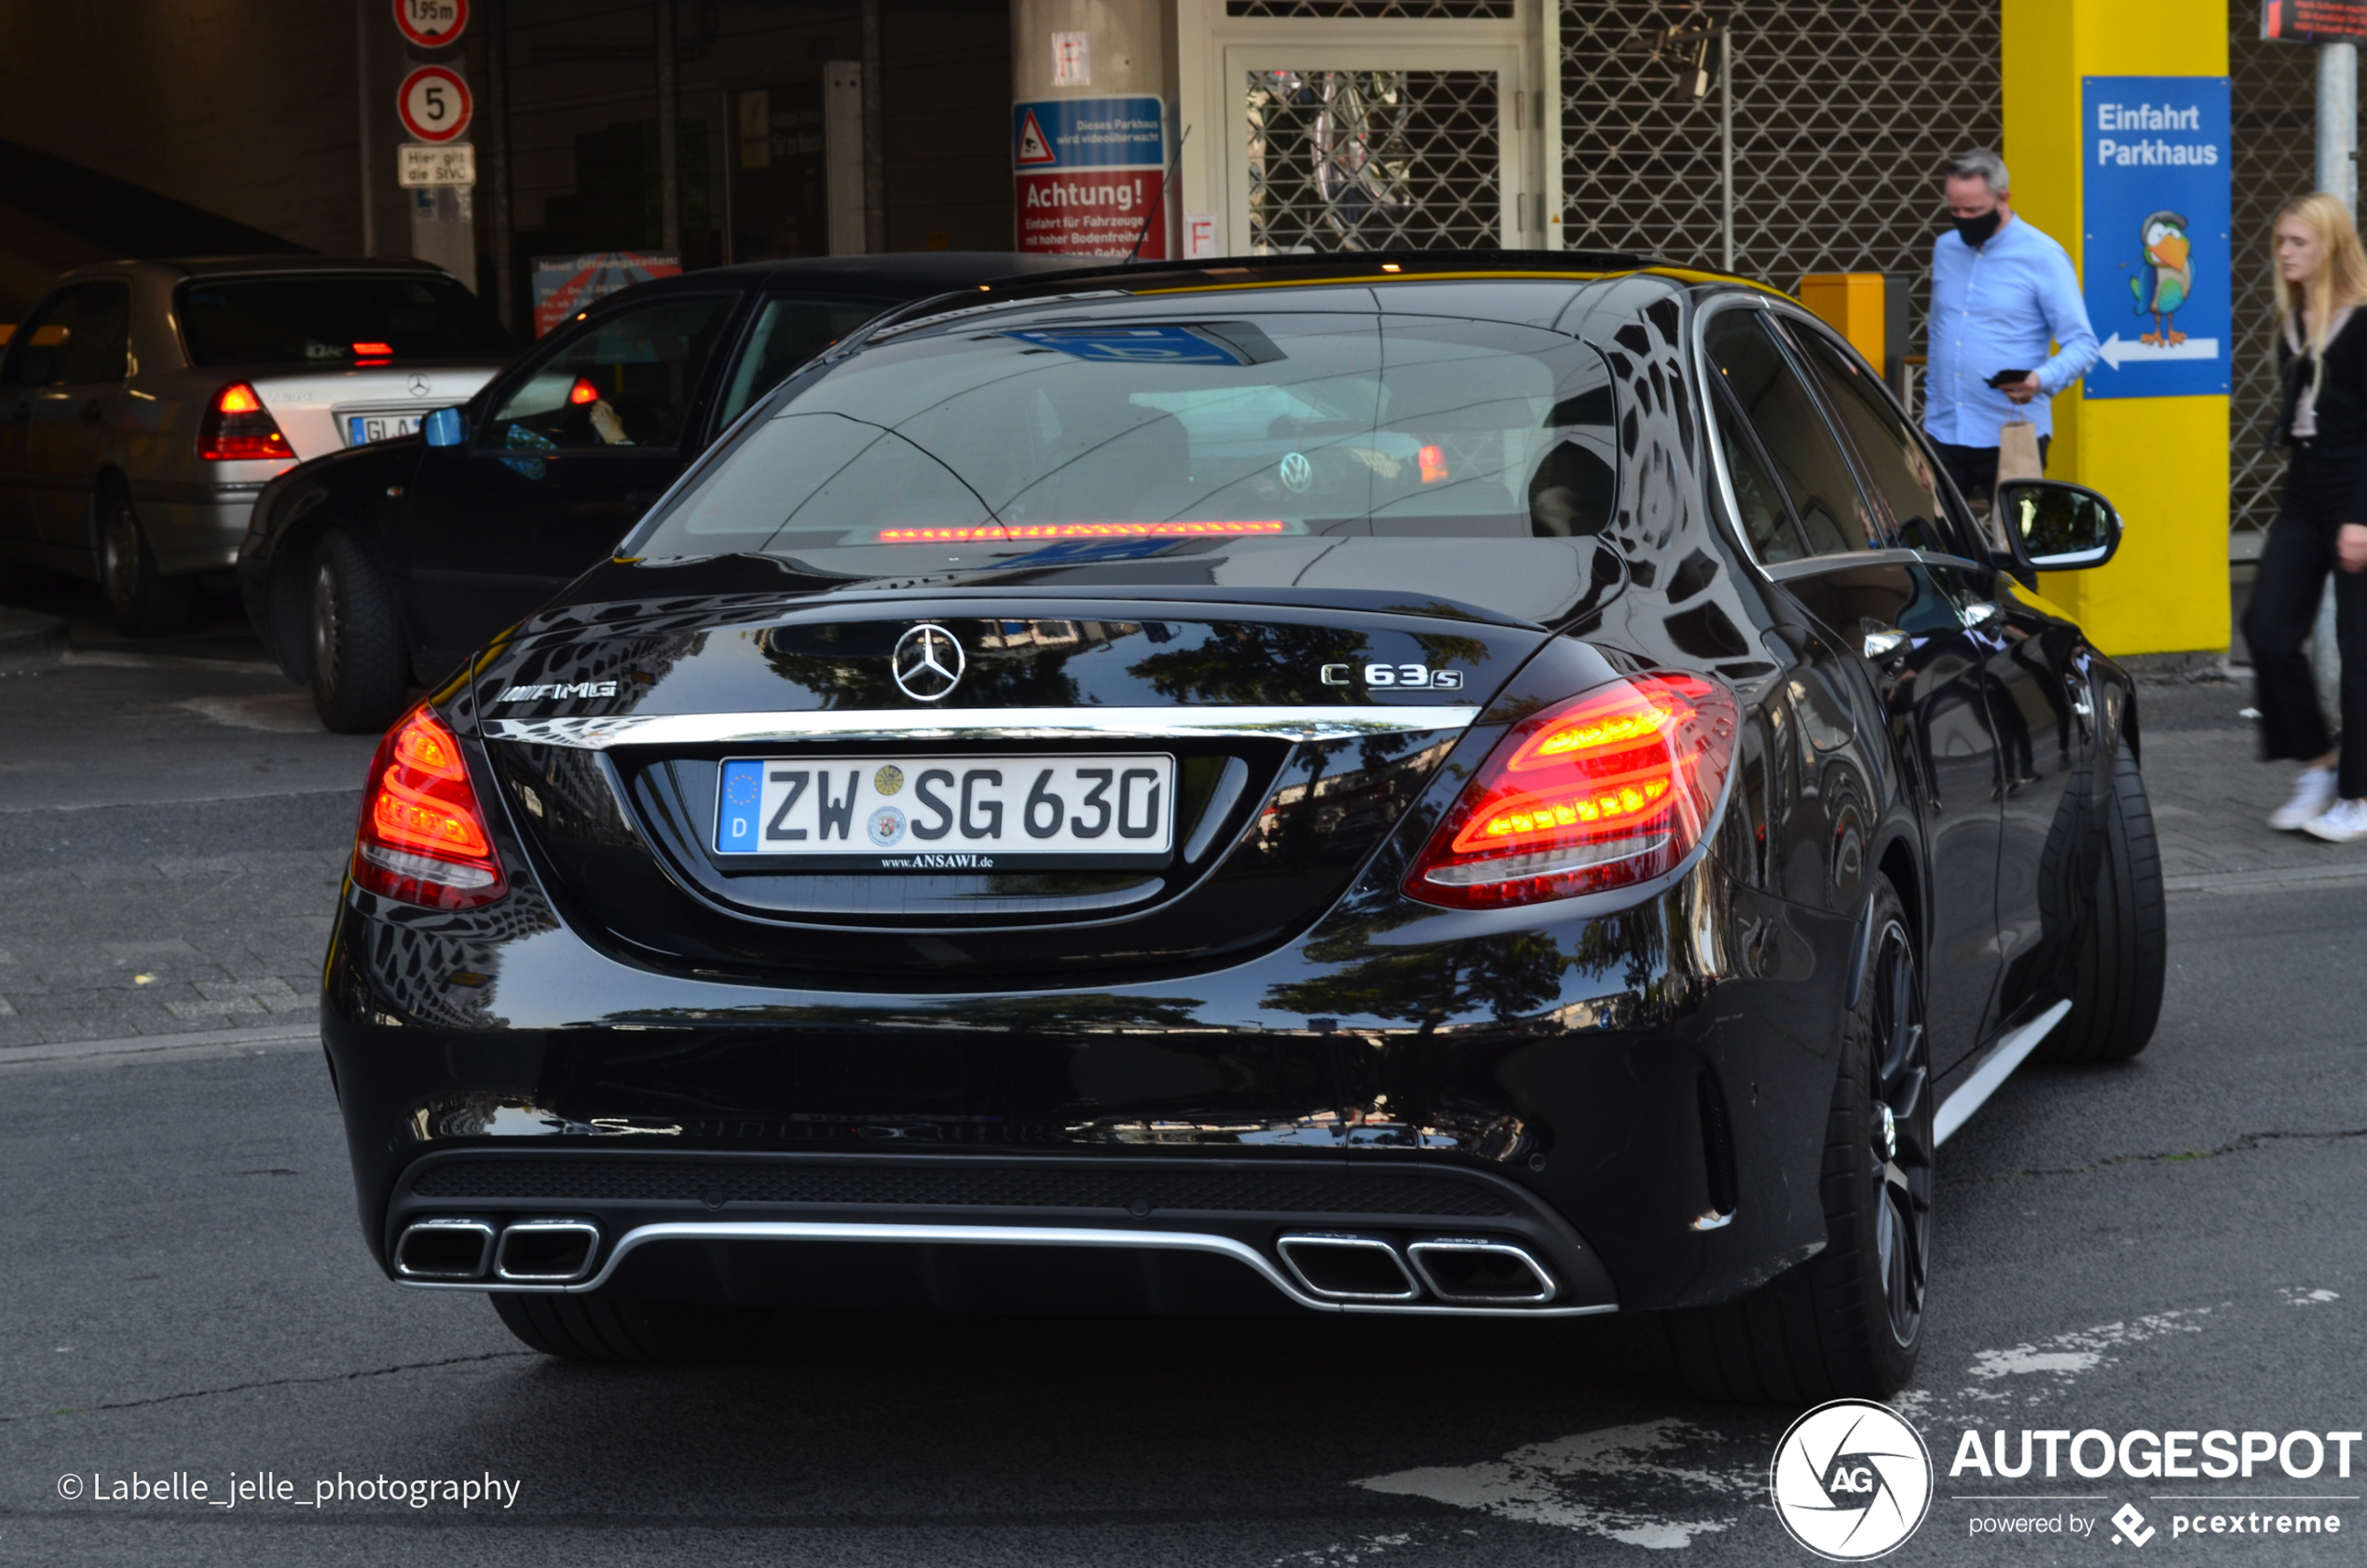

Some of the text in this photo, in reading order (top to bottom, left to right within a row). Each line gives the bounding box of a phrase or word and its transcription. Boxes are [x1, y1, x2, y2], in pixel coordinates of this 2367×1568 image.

[1059, 42, 1082, 78] F
[426, 88, 445, 120] 5
[1076, 118, 1158, 130] Dieses Parkhaus
[2099, 103, 2200, 130] Einfahrt
[1057, 131, 1159, 144] wird videoüberwacht
[408, 151, 464, 166] Hier gilt
[2099, 139, 2219, 166] Parkhaus
[408, 168, 429, 180] die
[1027, 179, 1142, 211] Achtung!
[1026, 215, 1144, 230] Einfahrt für Fahrzeuge
[1039, 233, 1069, 245] hoher
[1071, 231, 1148, 244] Bodenfreihet
[1193, 222, 1211, 254] F
[539, 260, 573, 272] Neue
[1320, 663, 1350, 686] C
[1364, 663, 1429, 686] 63
[528, 681, 617, 700] AMG
[766, 770, 859, 840] ZW
[910, 770, 1003, 839] SG
[1024, 769, 1160, 839] 630
[732, 818, 746, 838] D
[882, 854, 993, 867] www.ANSAWI.de
